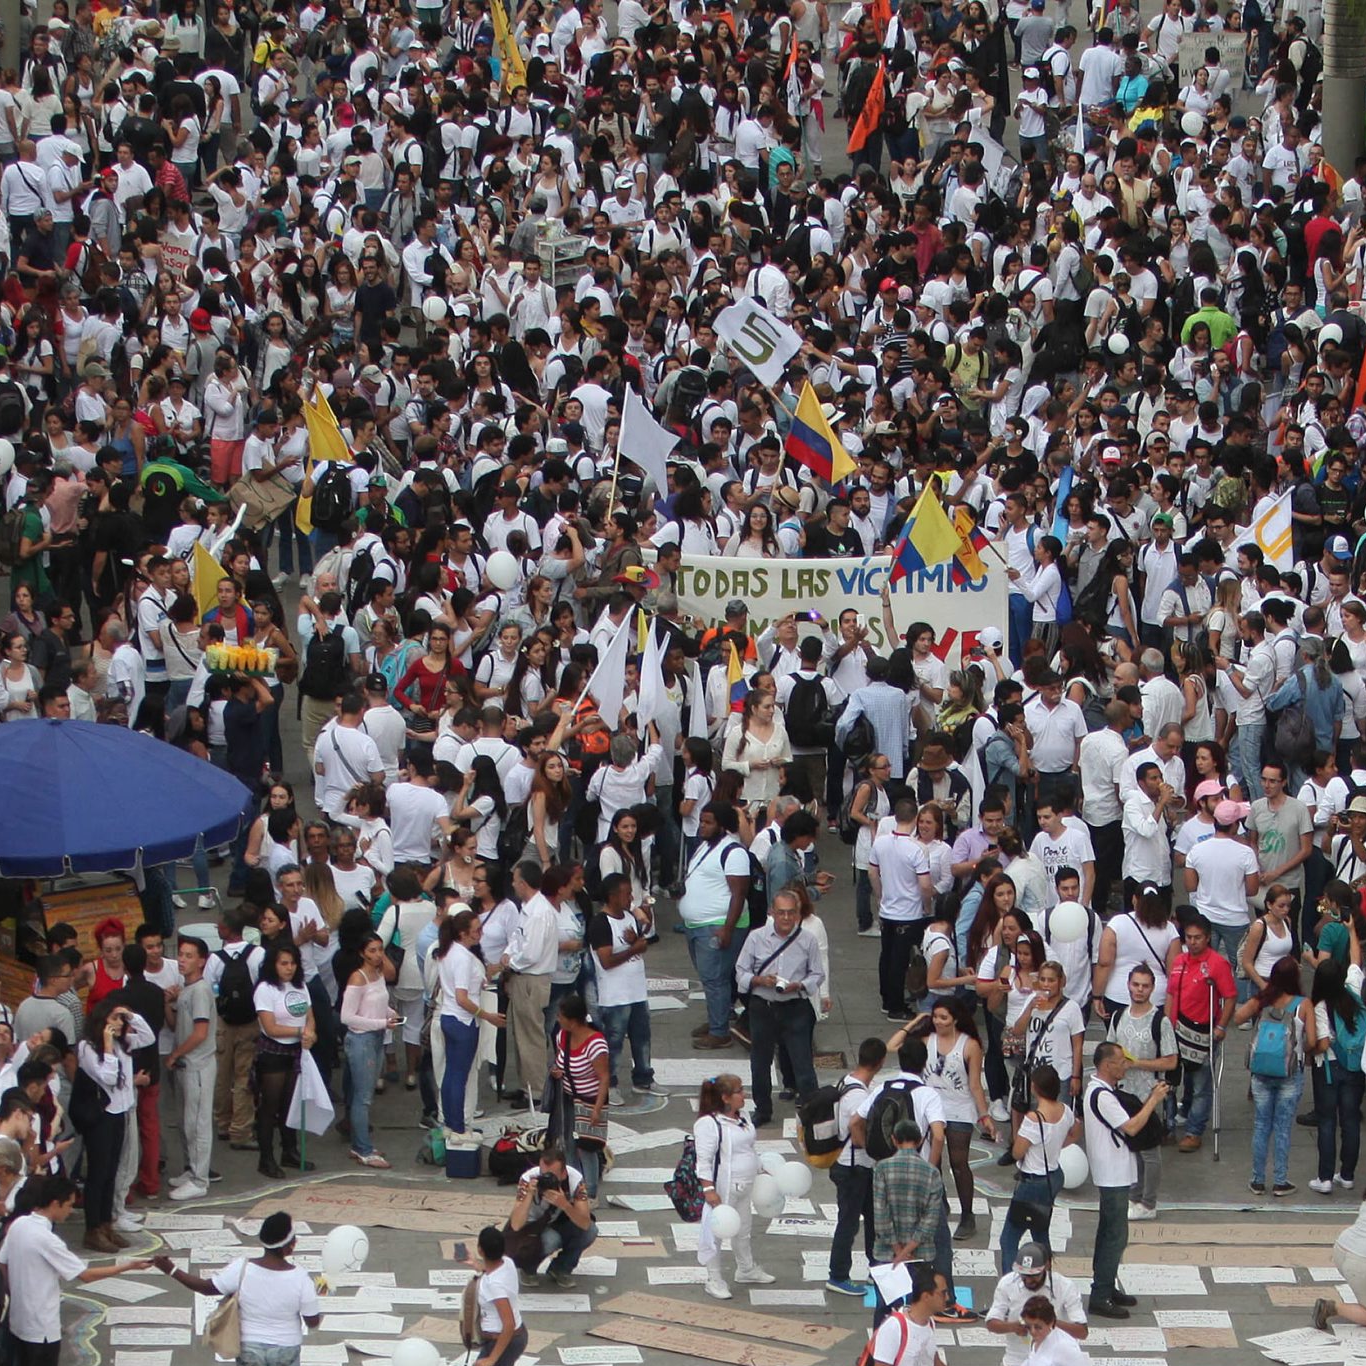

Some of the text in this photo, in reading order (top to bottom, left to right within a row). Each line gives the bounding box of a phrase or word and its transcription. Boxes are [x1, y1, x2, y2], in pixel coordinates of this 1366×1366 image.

[677, 565, 768, 598] TODAS
[781, 568, 832, 599] LAS
[1043, 846, 1068, 857] Don't
